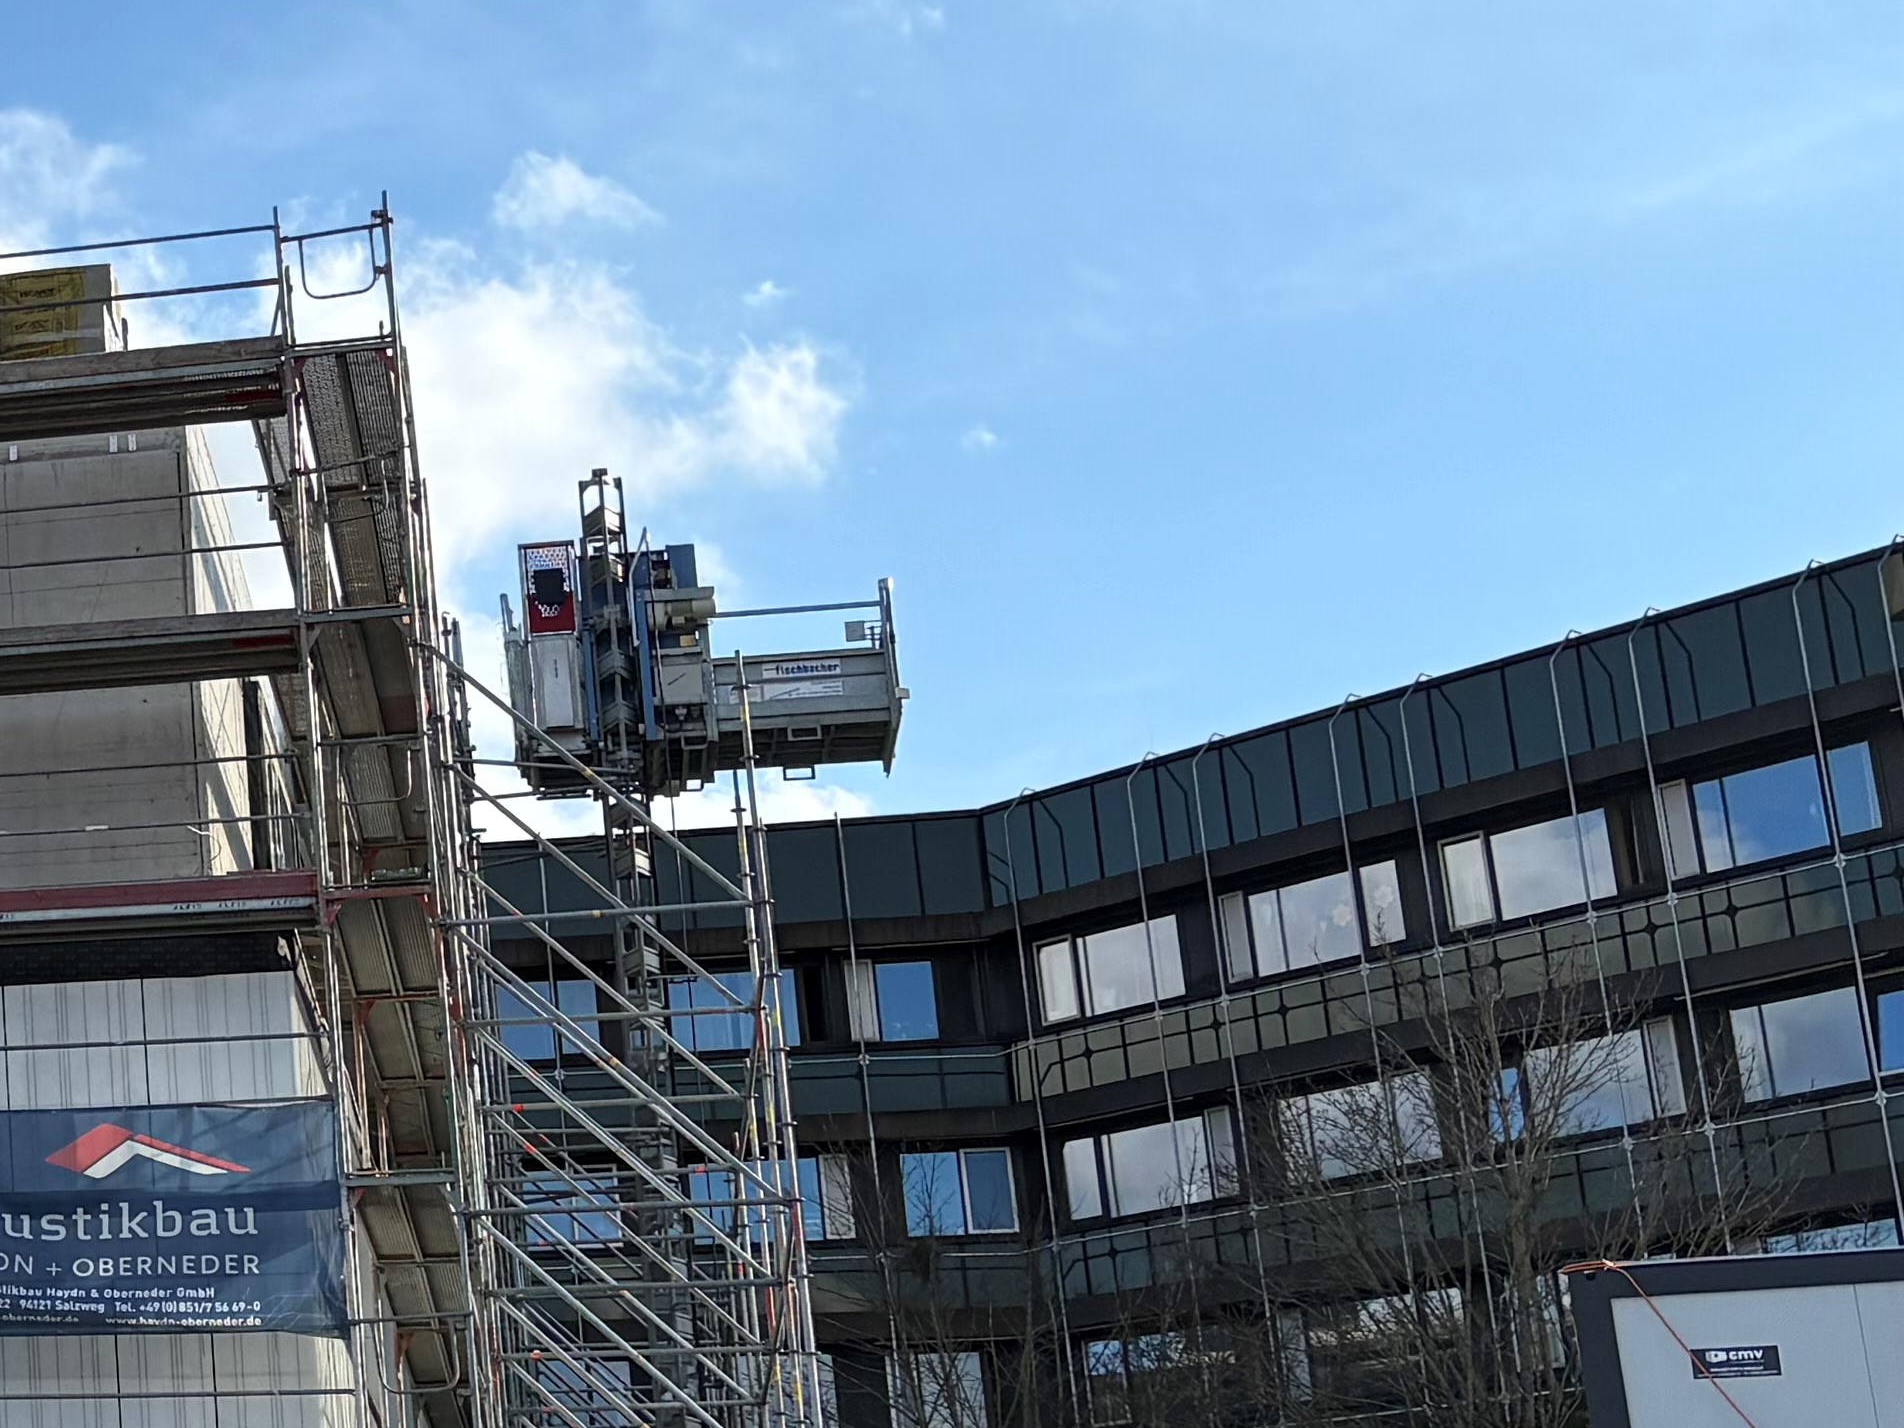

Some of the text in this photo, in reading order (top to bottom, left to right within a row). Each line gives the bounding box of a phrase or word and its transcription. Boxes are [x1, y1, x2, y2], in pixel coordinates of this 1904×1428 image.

[45, 1261, 63, 1277] +
[72, 1253, 260, 1277] OBERNEDER
[46, 1287, 86, 1299] Haydn
[90, 1288, 100, 1298] &
[103, 1287, 173, 1299] Oberneder
[176, 1287, 215, 1299] GmbH
[55, 1300, 105, 1314] Salzweg
[115, 1301, 136, 1313] Tel.
[215, 1302, 229, 1313] 56
[232, 1301, 261, 1313] 69-0
